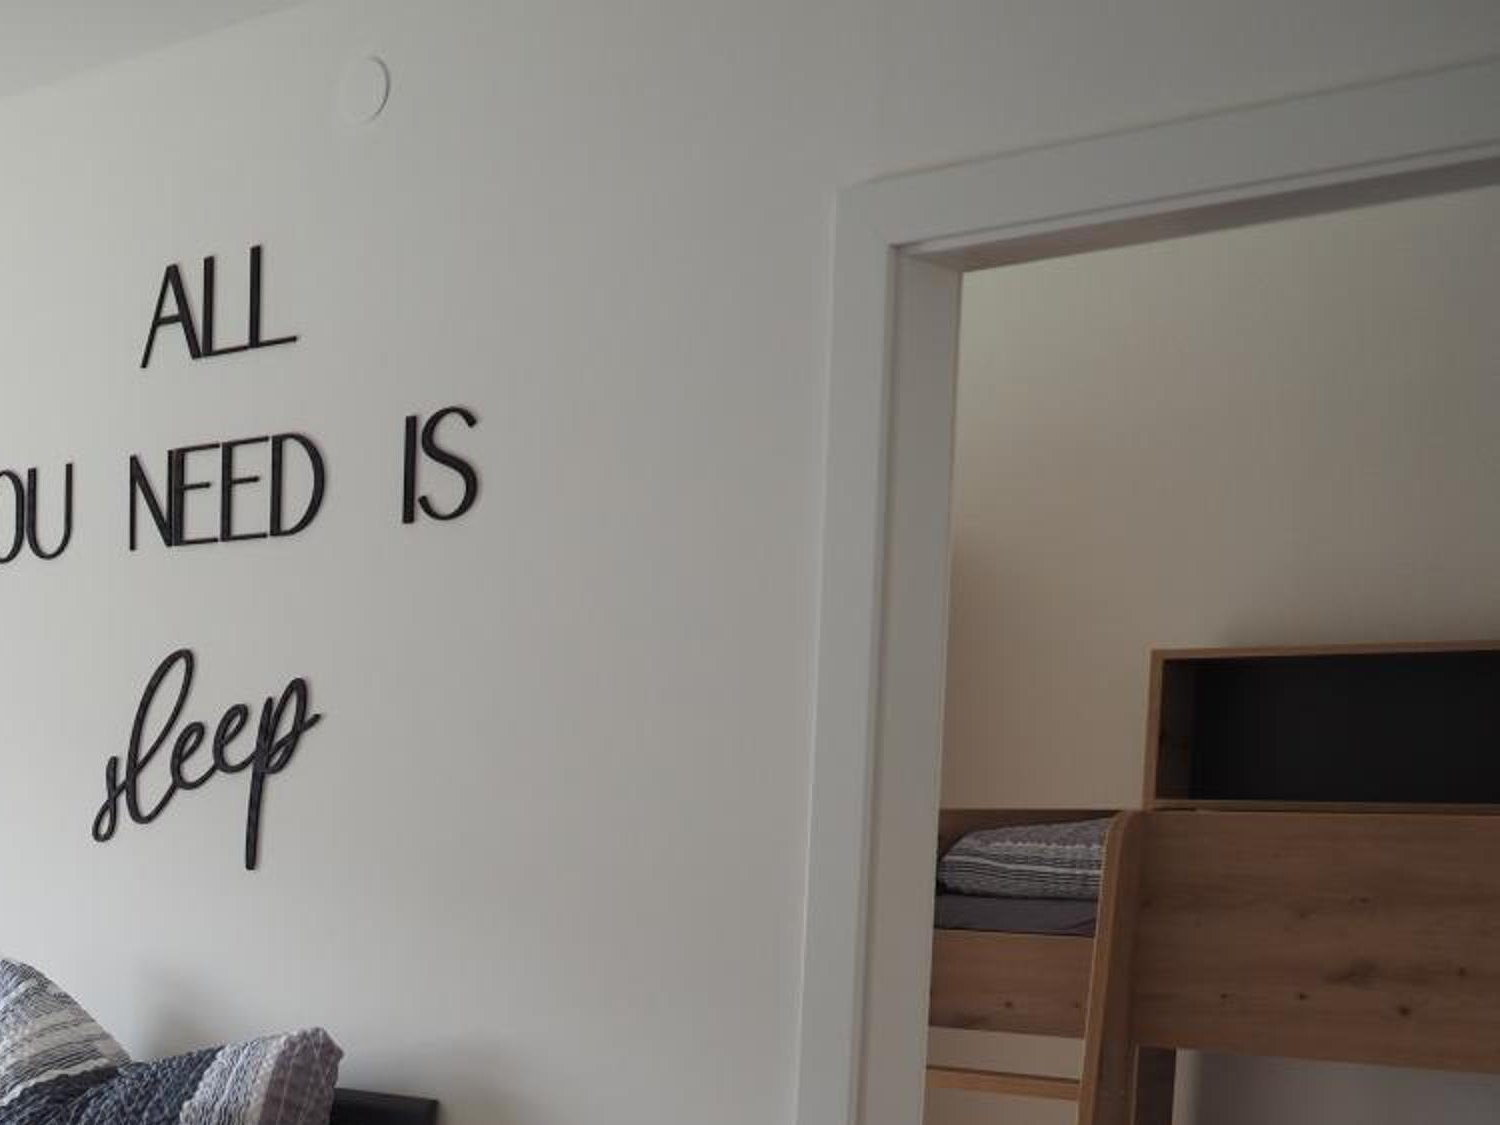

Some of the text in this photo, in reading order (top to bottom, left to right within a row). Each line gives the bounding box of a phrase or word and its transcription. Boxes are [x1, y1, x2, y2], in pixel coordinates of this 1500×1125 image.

[140, 244, 299, 369] ALL
[129, 432, 326, 551] NEED
[402, 405, 481, 525] IS
[91, 648, 323, 871] sleep
